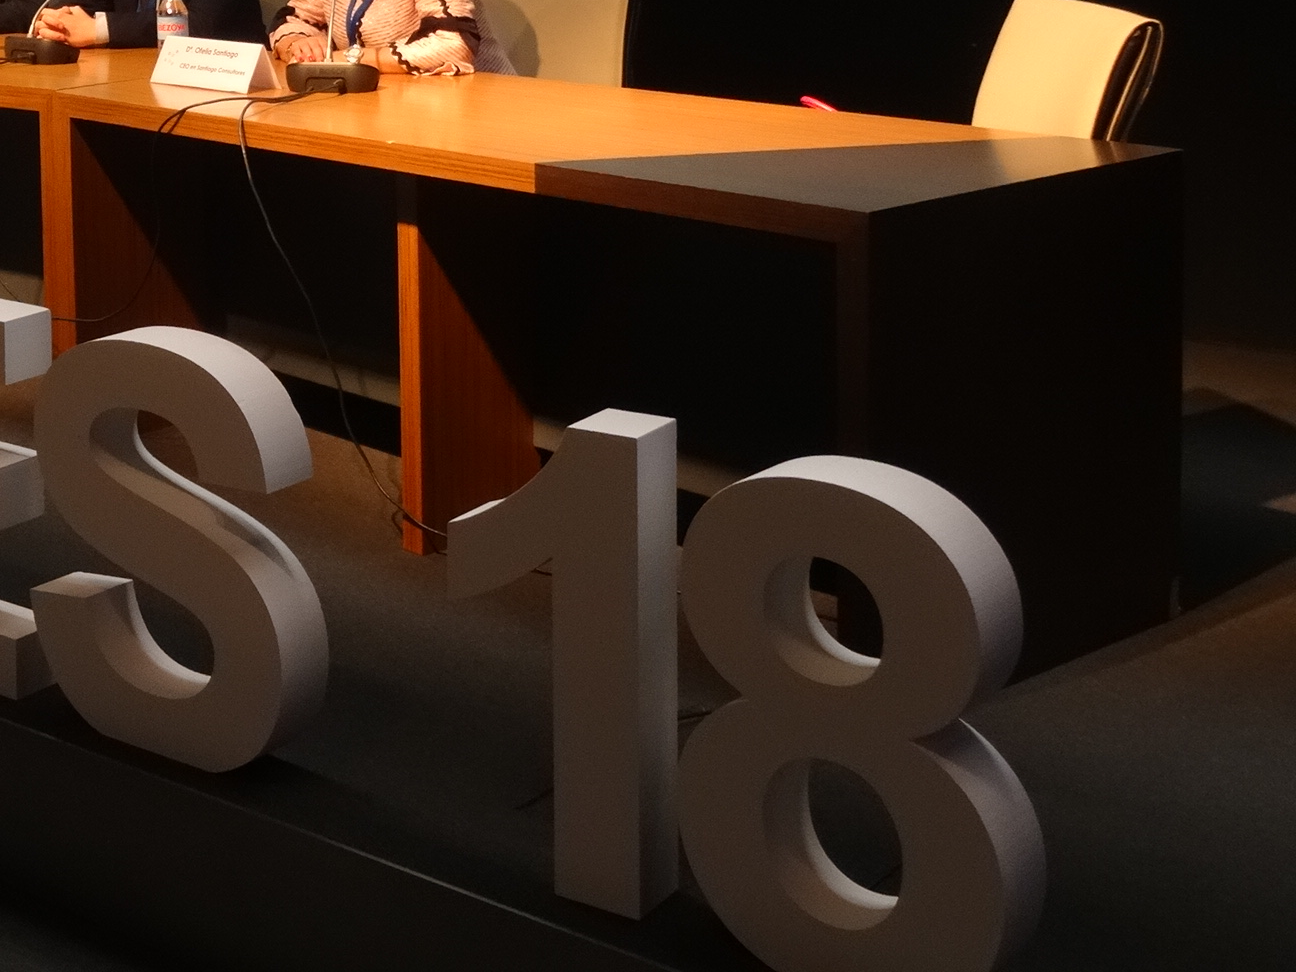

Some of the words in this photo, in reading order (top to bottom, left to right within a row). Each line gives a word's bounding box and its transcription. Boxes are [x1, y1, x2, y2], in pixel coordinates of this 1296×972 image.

[195, 47, 212, 55] Ofelia
[213, 48, 239, 59] Santiago
[197, 65, 218, 73] Santiago
[218, 67, 246, 76] Consultores
[447, 407, 1048, 972] 18
